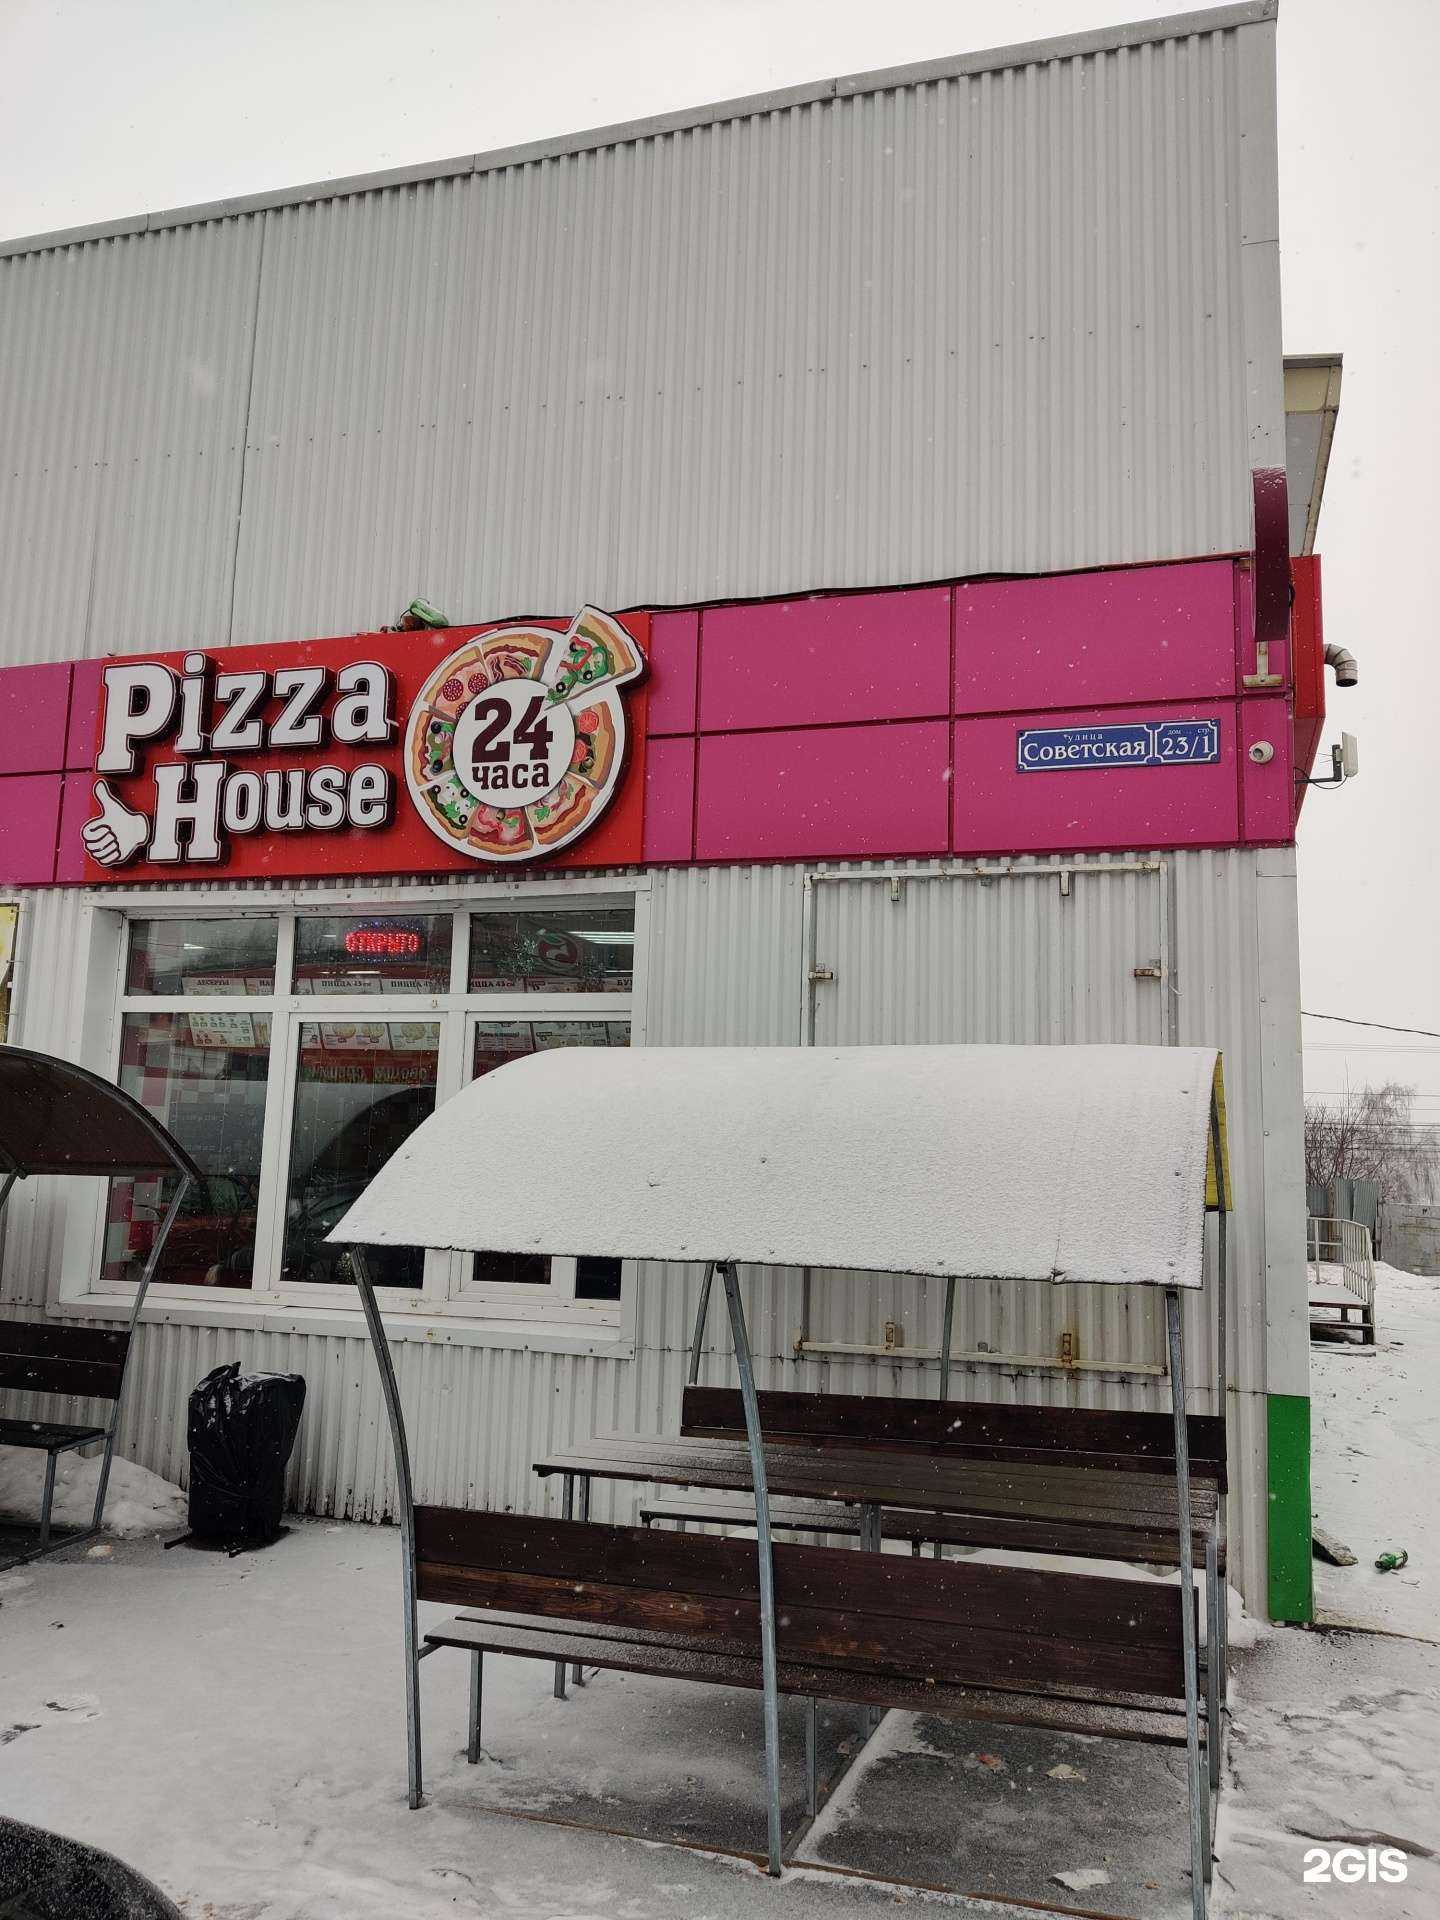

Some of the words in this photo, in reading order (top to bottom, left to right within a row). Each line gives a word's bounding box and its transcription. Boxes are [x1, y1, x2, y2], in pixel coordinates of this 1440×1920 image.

[97, 652, 391, 774] Pizza
[472, 695, 554, 763] 24
[1023, 740, 1147, 761] Советская
[1161, 734, 1210, 758] 23/1
[471, 762, 550, 790] часа
[147, 760, 389, 864] House
